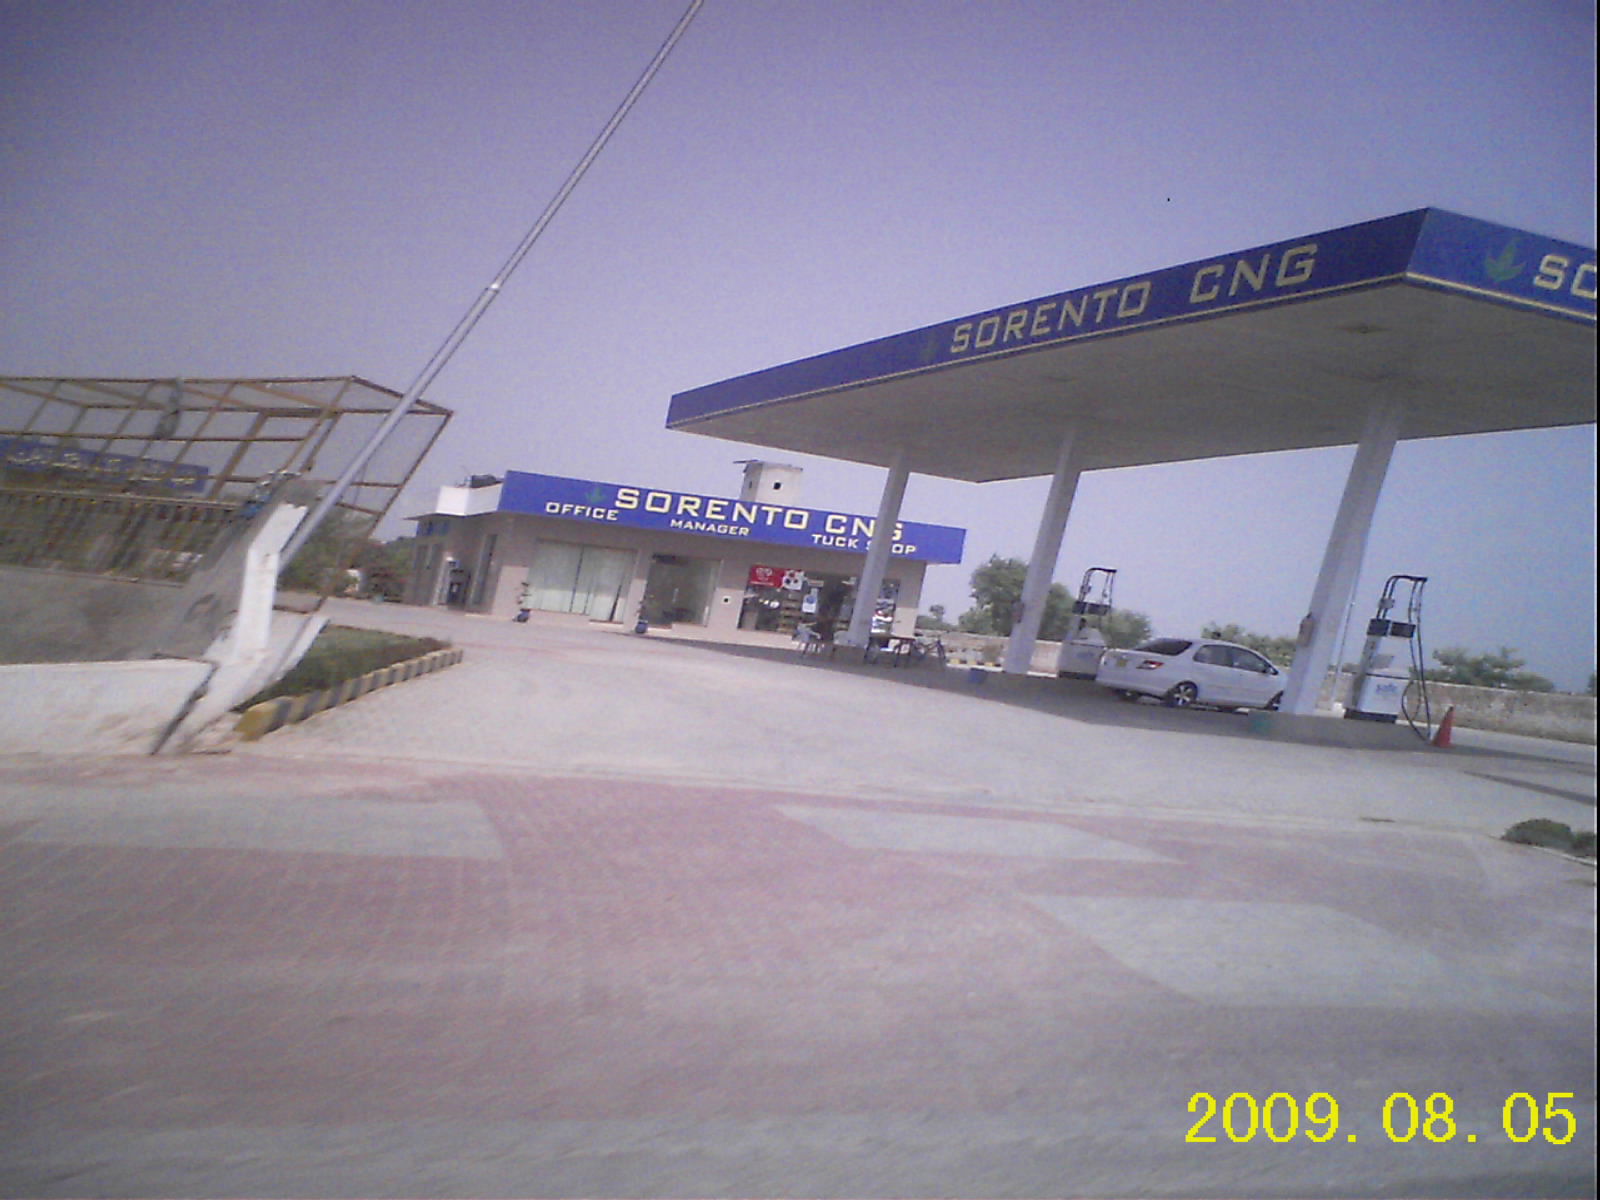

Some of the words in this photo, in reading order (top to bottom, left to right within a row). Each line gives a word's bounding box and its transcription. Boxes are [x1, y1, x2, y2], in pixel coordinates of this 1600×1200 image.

[951, 281, 1151, 352] SORENTO
[1189, 243, 1318, 303] CNG
[545, 502, 619, 521] OFFICE
[614, 487, 809, 530] SORENTO
[669, 519, 750, 536] MANAGER
[811, 534, 859, 549] TUCK
[866, 540, 917, 555] OP
